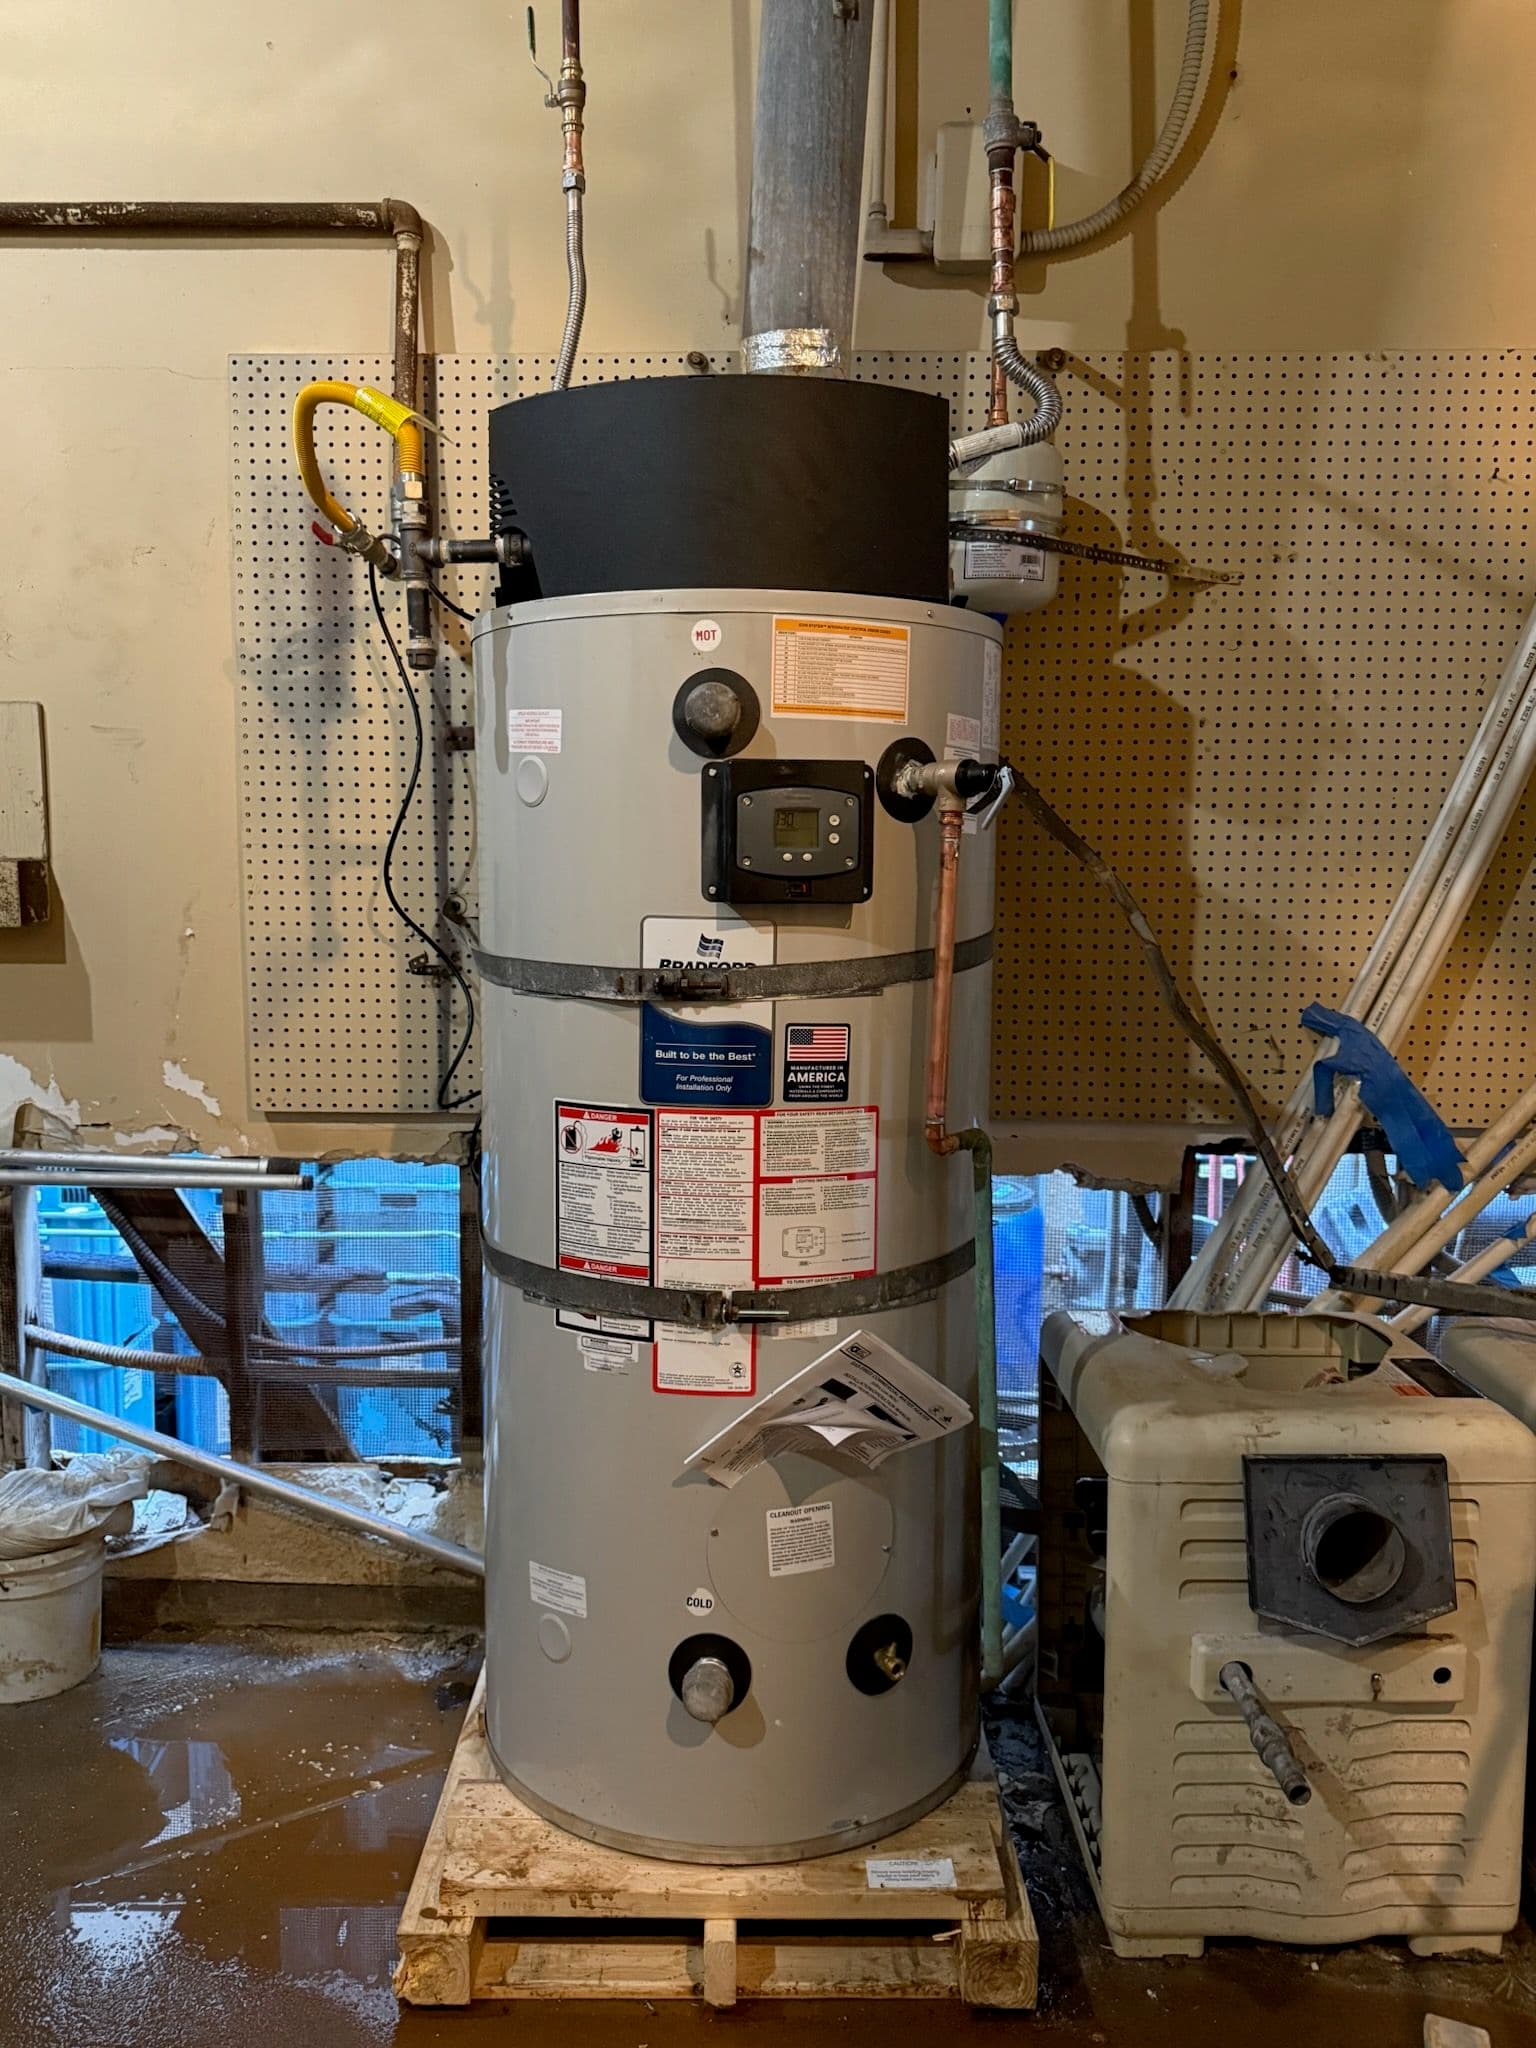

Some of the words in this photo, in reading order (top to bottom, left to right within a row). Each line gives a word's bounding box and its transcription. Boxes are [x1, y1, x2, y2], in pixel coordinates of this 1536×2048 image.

[696, 630, 717, 641] HOT
[656, 1049, 677, 1059] Built
[680, 1050, 690, 1060] to
[692, 1050, 706, 1060] be
[709, 1051, 725, 1061] the
[676, 1074, 688, 1082] For
[690, 1074, 734, 1083] Professional
[787, 1072, 846, 1082] AMERICA
[676, 1083, 714, 1092] Installation
[716, 1084, 732, 1093] Only
[590, 1263, 617, 1272] DANGER
[770, 1508, 802, 1518] CLEANOUT
[804, 1504, 831, 1514] OPENING
[686, 1596, 713, 1608] COLD
